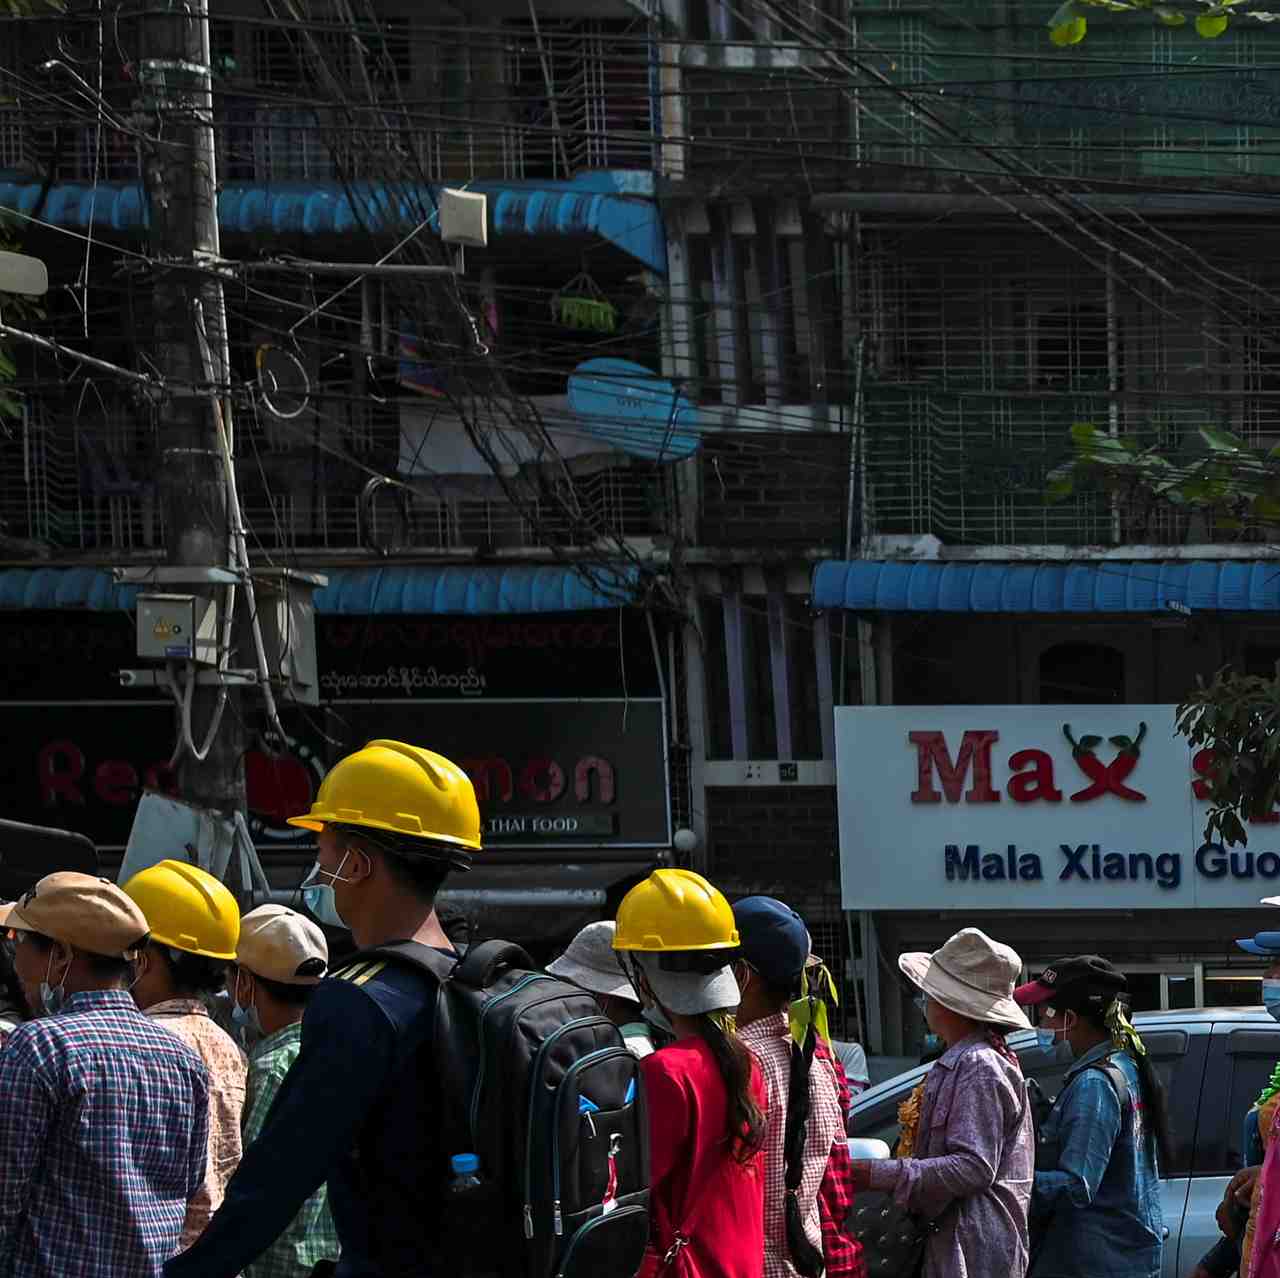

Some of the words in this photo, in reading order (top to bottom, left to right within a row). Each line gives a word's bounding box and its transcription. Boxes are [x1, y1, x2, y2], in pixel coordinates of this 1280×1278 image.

[909, 722, 1147, 803] Max
[489, 816, 526, 832] THAI
[531, 816, 579, 832] FOOD
[945, 844, 1042, 882] Mala
[1059, 844, 1181, 889] Xiang
